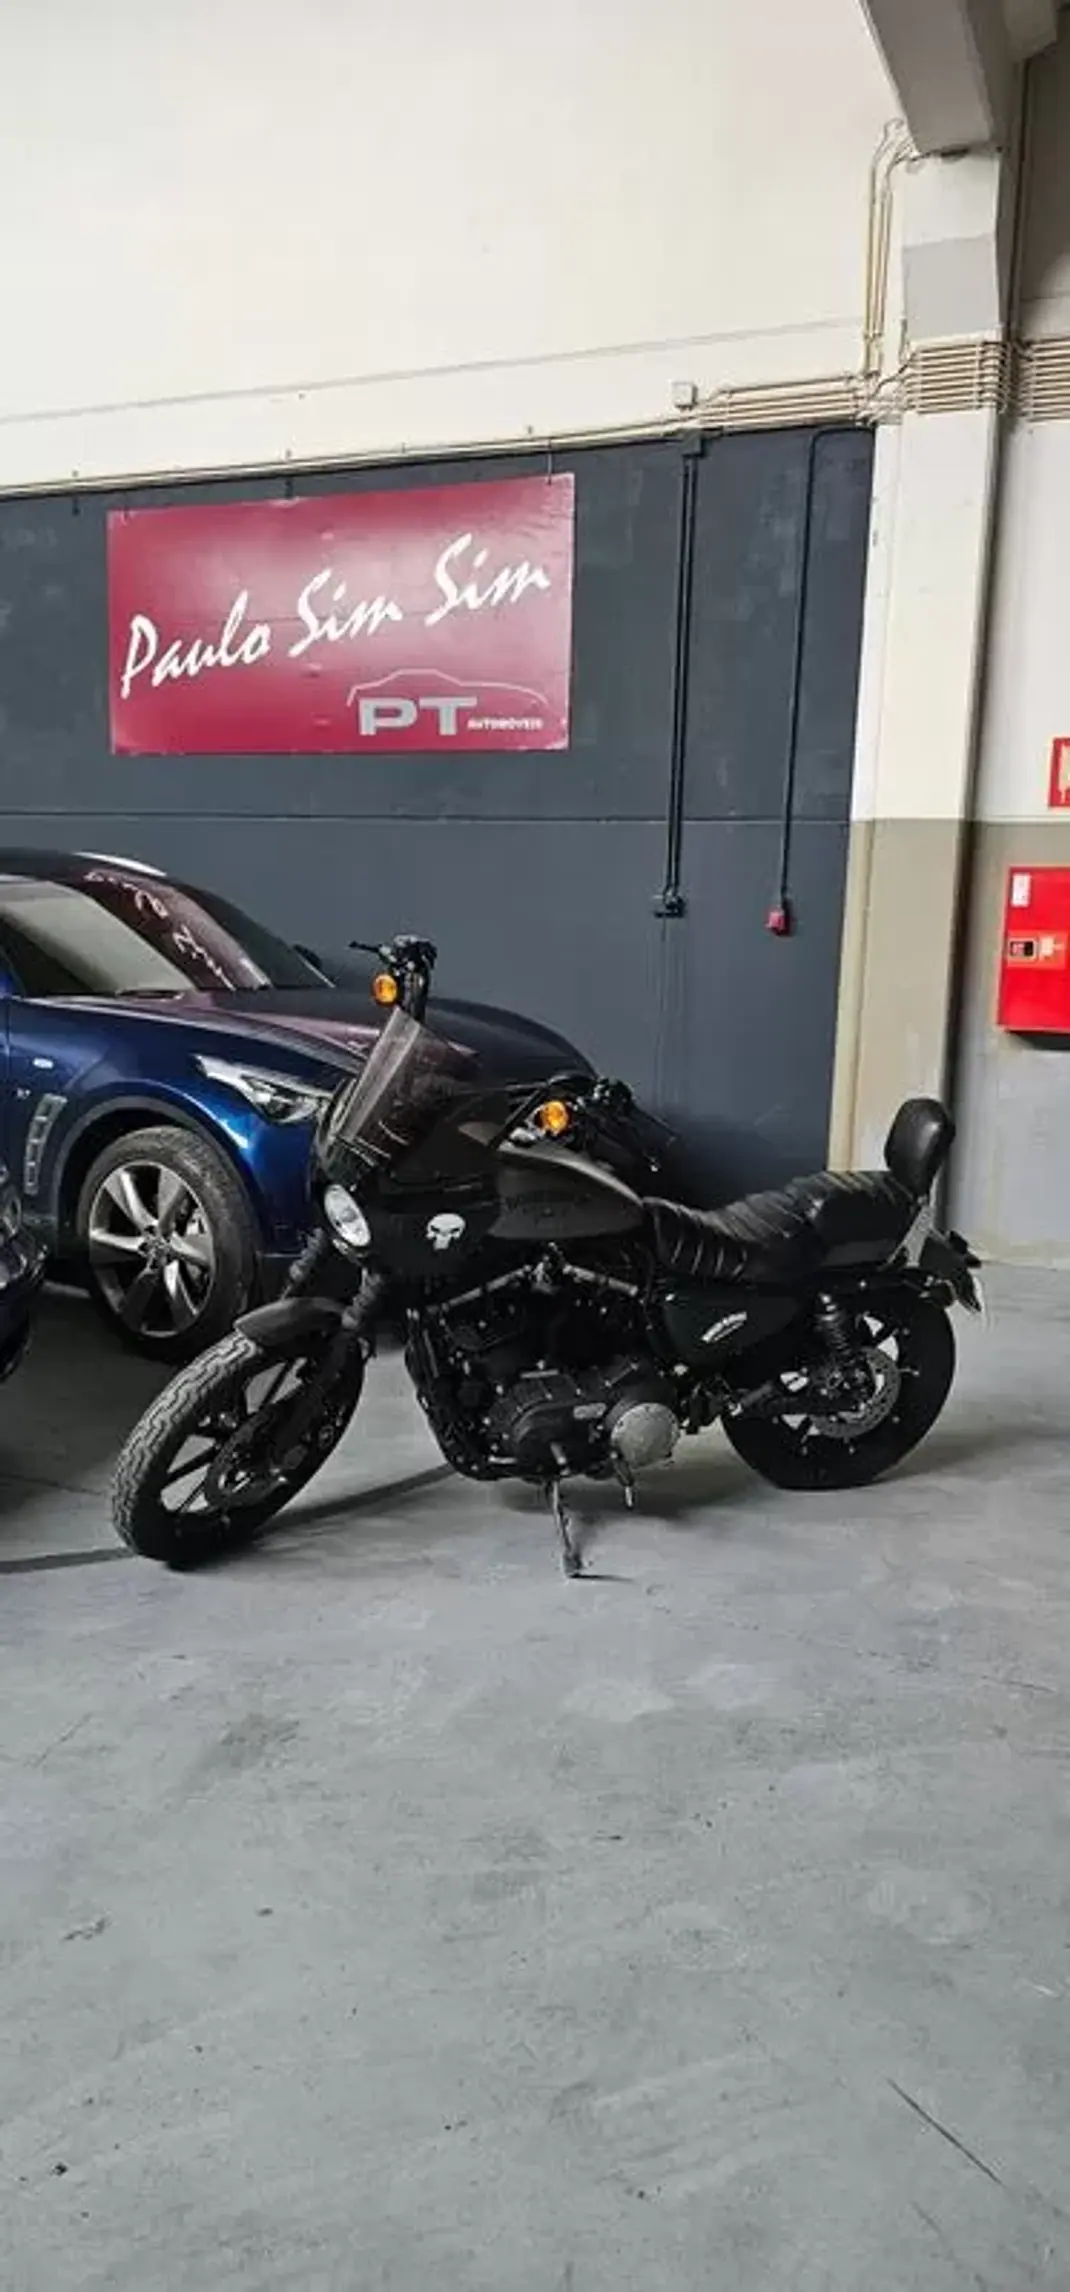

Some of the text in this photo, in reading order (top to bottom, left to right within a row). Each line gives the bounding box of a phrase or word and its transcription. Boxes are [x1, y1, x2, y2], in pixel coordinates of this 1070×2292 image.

[120, 533, 550, 699] Paulo Sim Sim
[359, 696, 478, 736] PT
